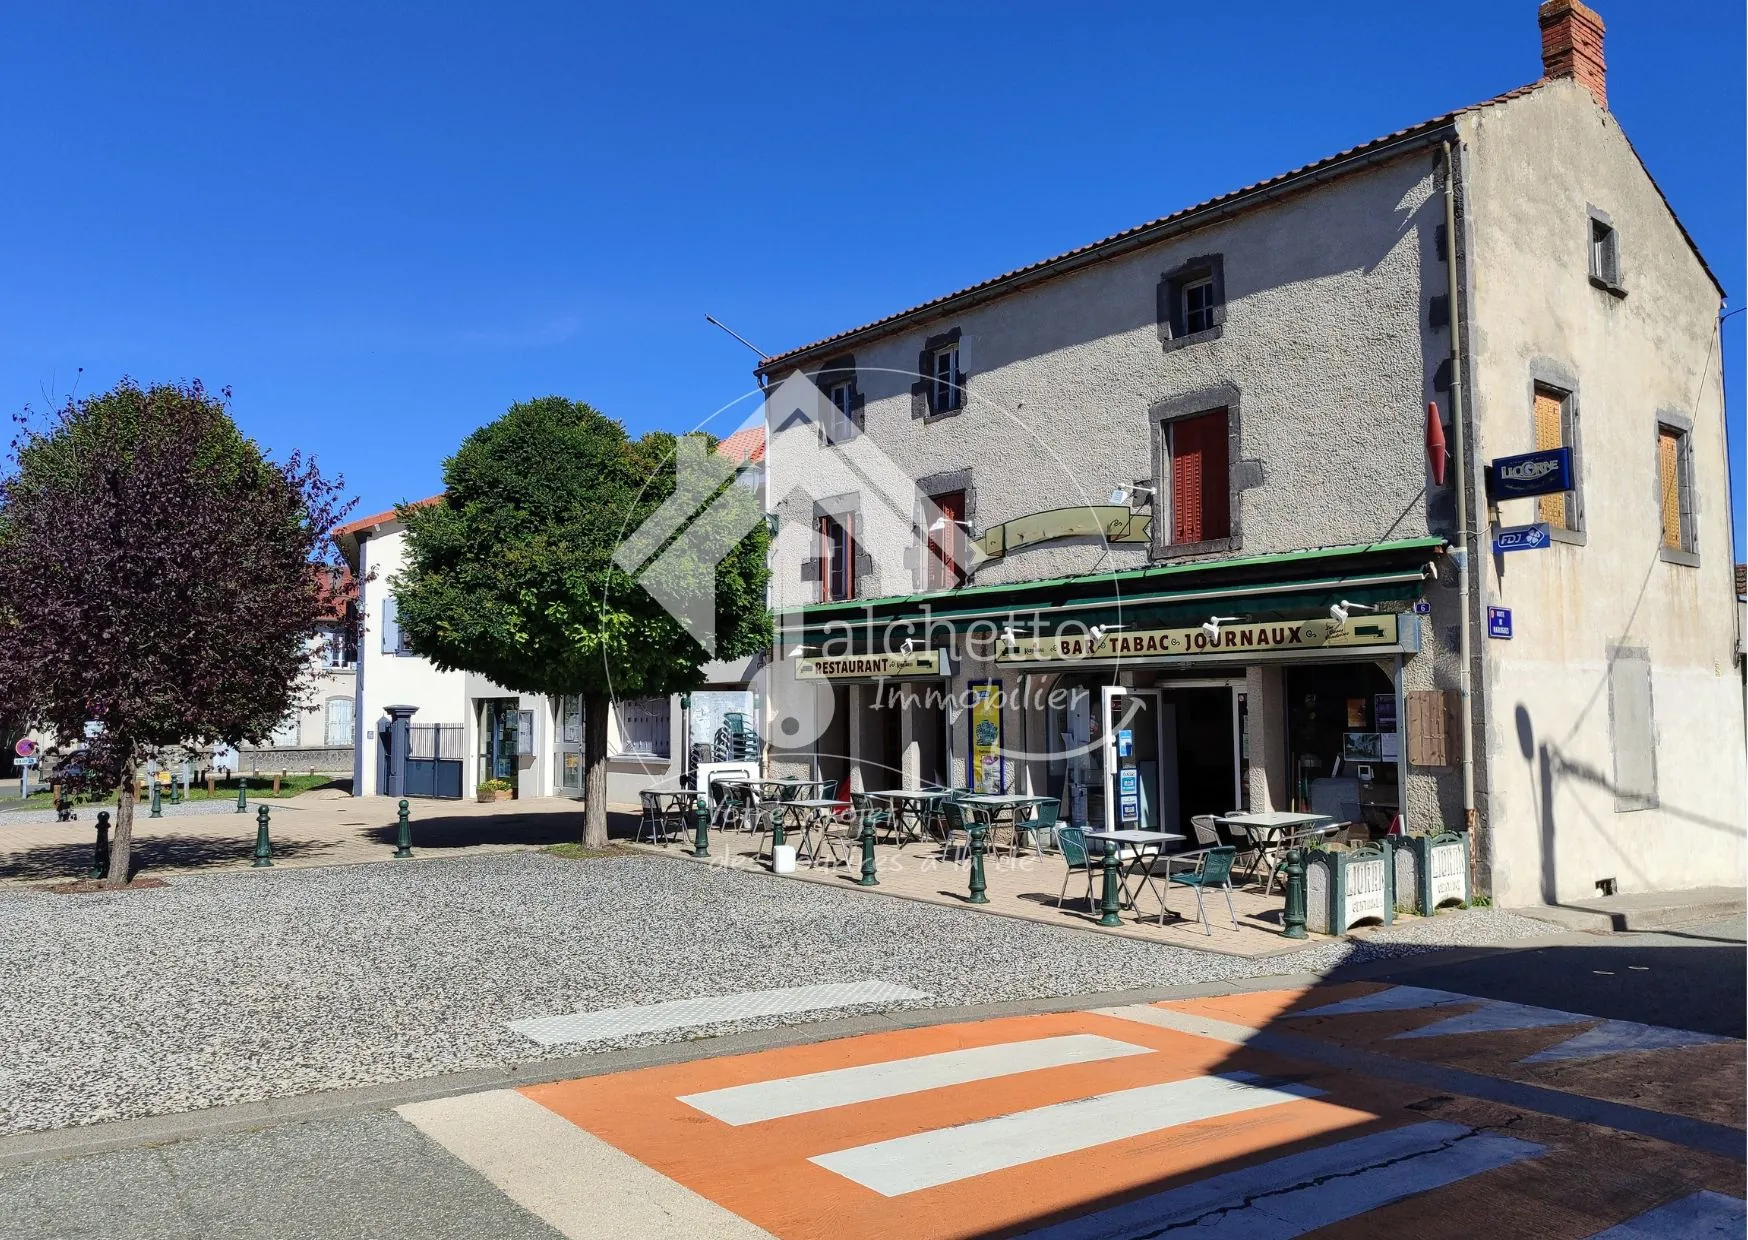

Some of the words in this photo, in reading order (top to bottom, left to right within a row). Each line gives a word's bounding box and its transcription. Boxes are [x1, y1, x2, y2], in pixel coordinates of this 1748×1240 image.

[1501, 459, 1559, 479] LICORNE
[1501, 533, 1522, 545] FDJ
[1060, 639, 1095, 655] BAR
[1109, 634, 1169, 653] TABAC
[1185, 626, 1303, 652] JOURNAUX
[815, 658, 889, 675] RESTAURANT
